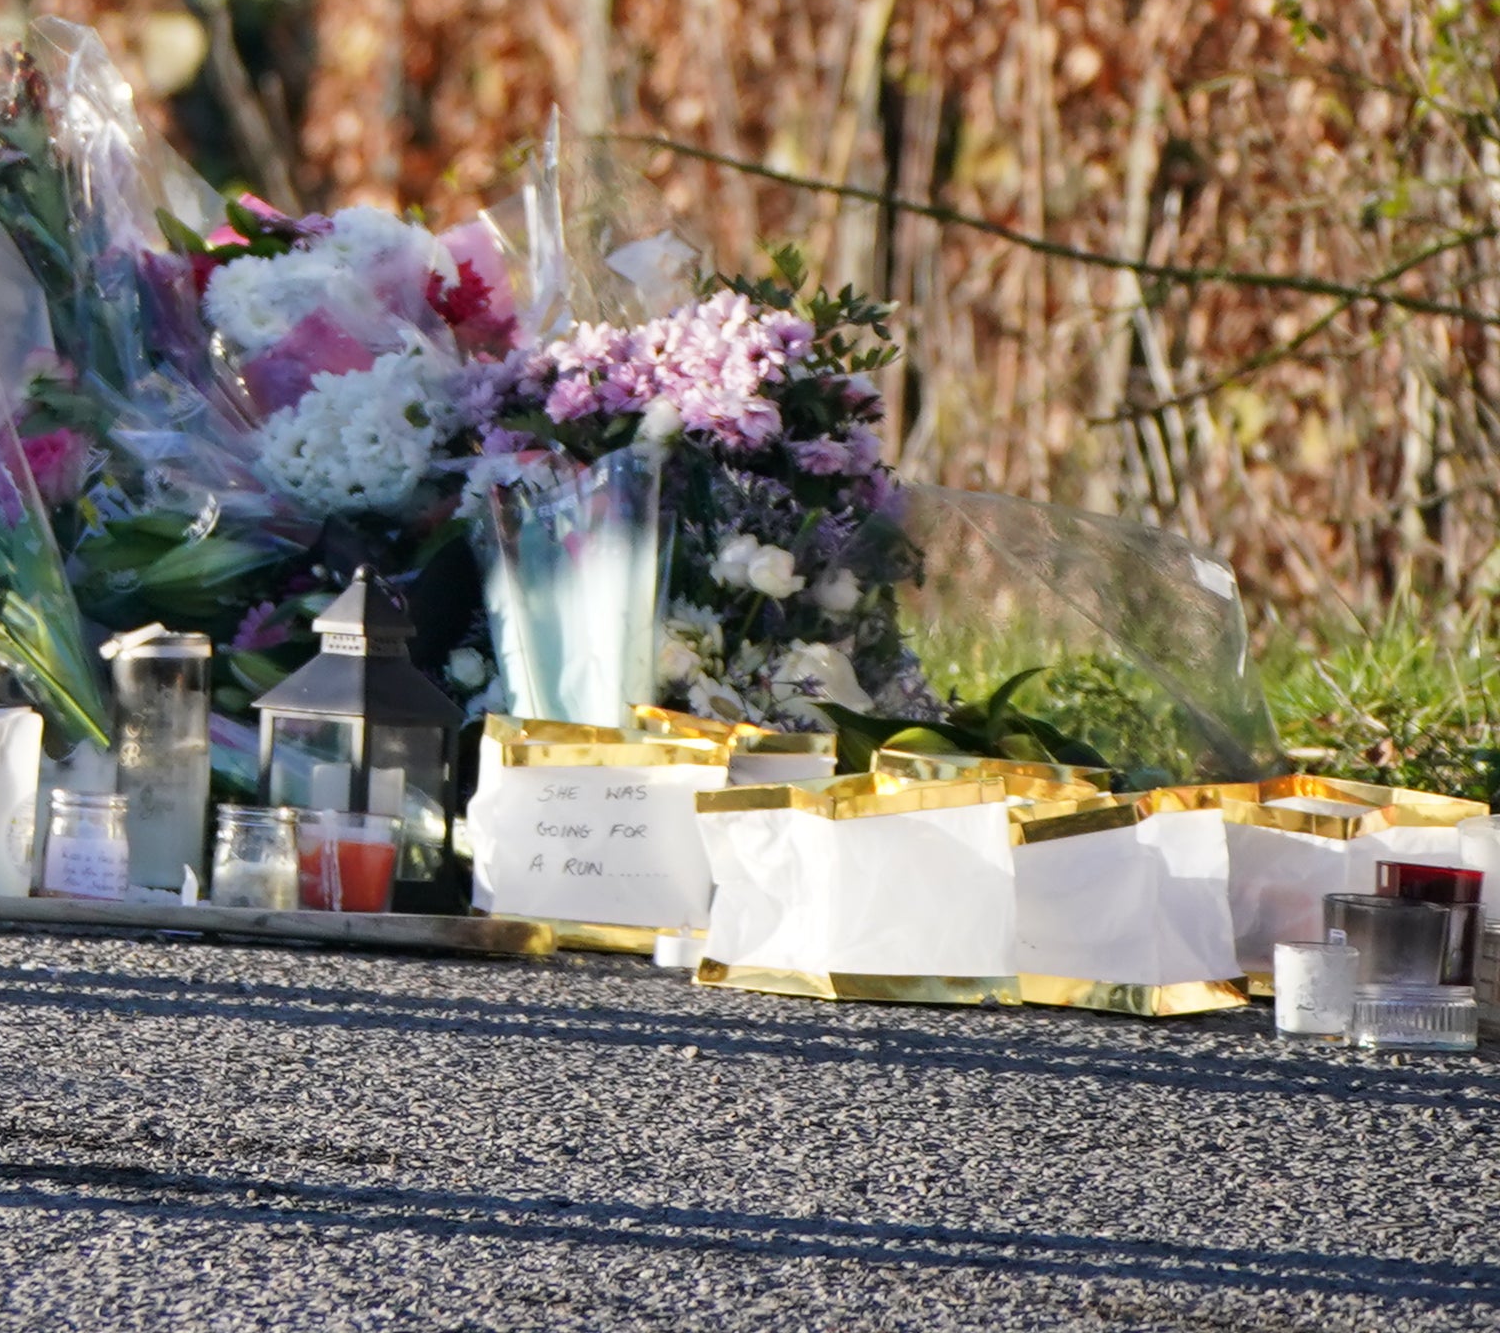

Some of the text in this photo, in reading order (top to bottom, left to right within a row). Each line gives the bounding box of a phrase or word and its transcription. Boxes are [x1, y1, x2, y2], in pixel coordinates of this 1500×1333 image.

[537, 785, 649, 802] SHE WAS
[537, 821, 648, 838] GOING FOR
[529, 853, 544, 872] A
